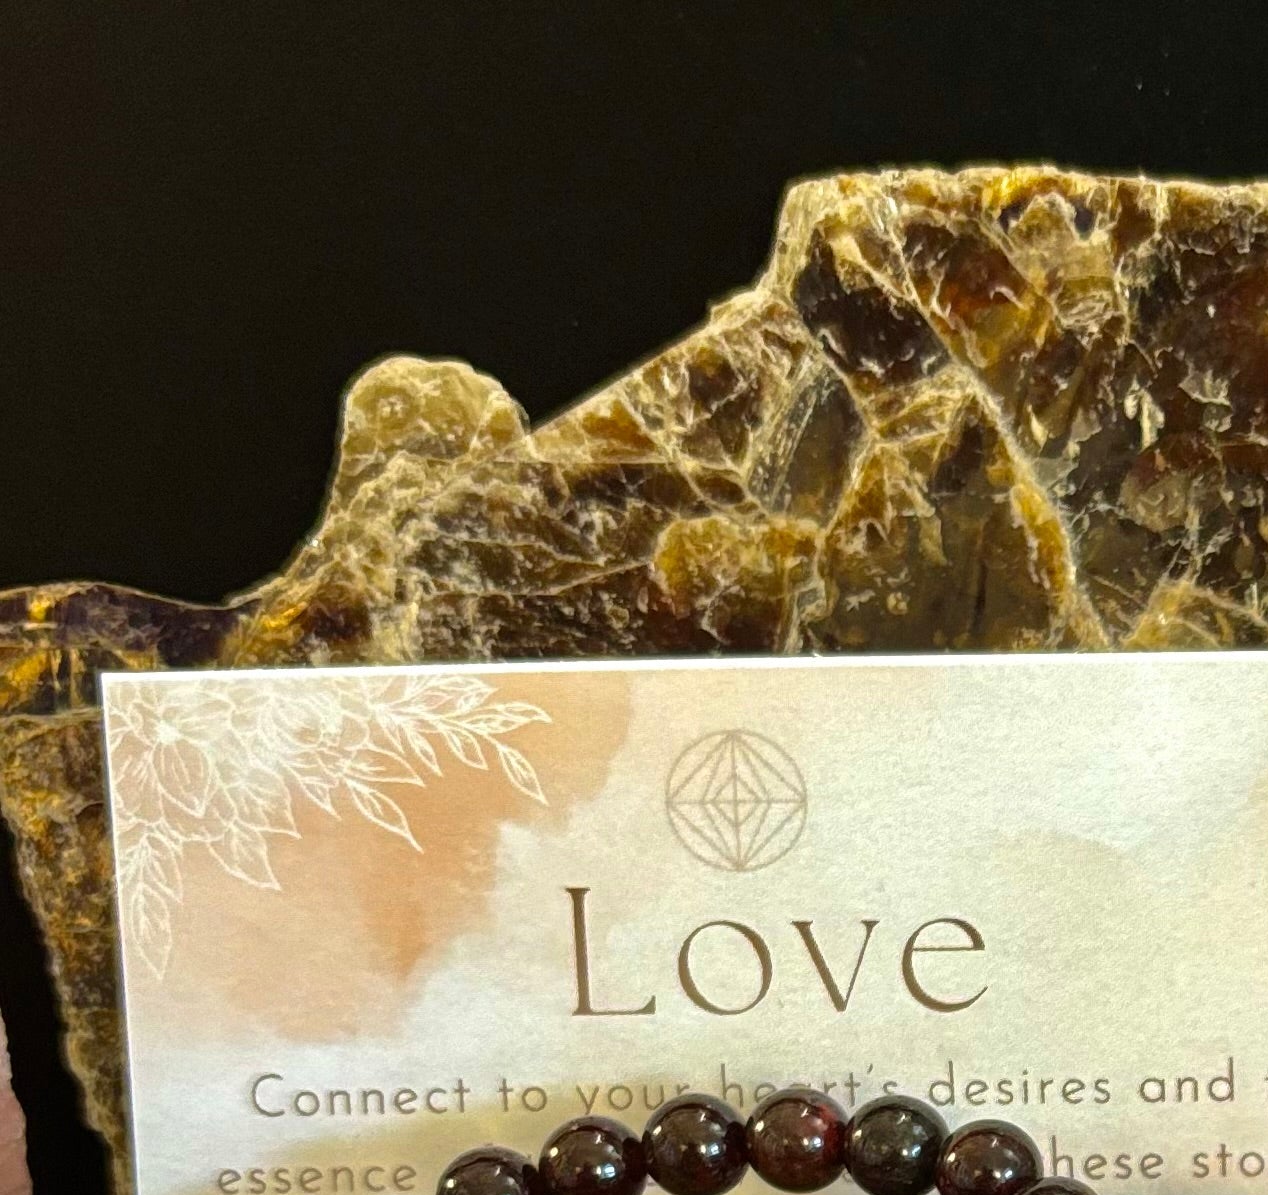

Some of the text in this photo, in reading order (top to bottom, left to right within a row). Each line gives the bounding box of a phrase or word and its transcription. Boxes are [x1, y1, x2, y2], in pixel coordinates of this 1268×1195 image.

[563, 885, 989, 1017] Love
[250, 1072, 471, 1119] Connect
[497, 1077, 549, 1115] to
[928, 1060, 1112, 1107] desires
[1138, 1056, 1236, 1104] and
[217, 1162, 417, 1195] essence
[1050, 1135, 1164, 1181] hese
